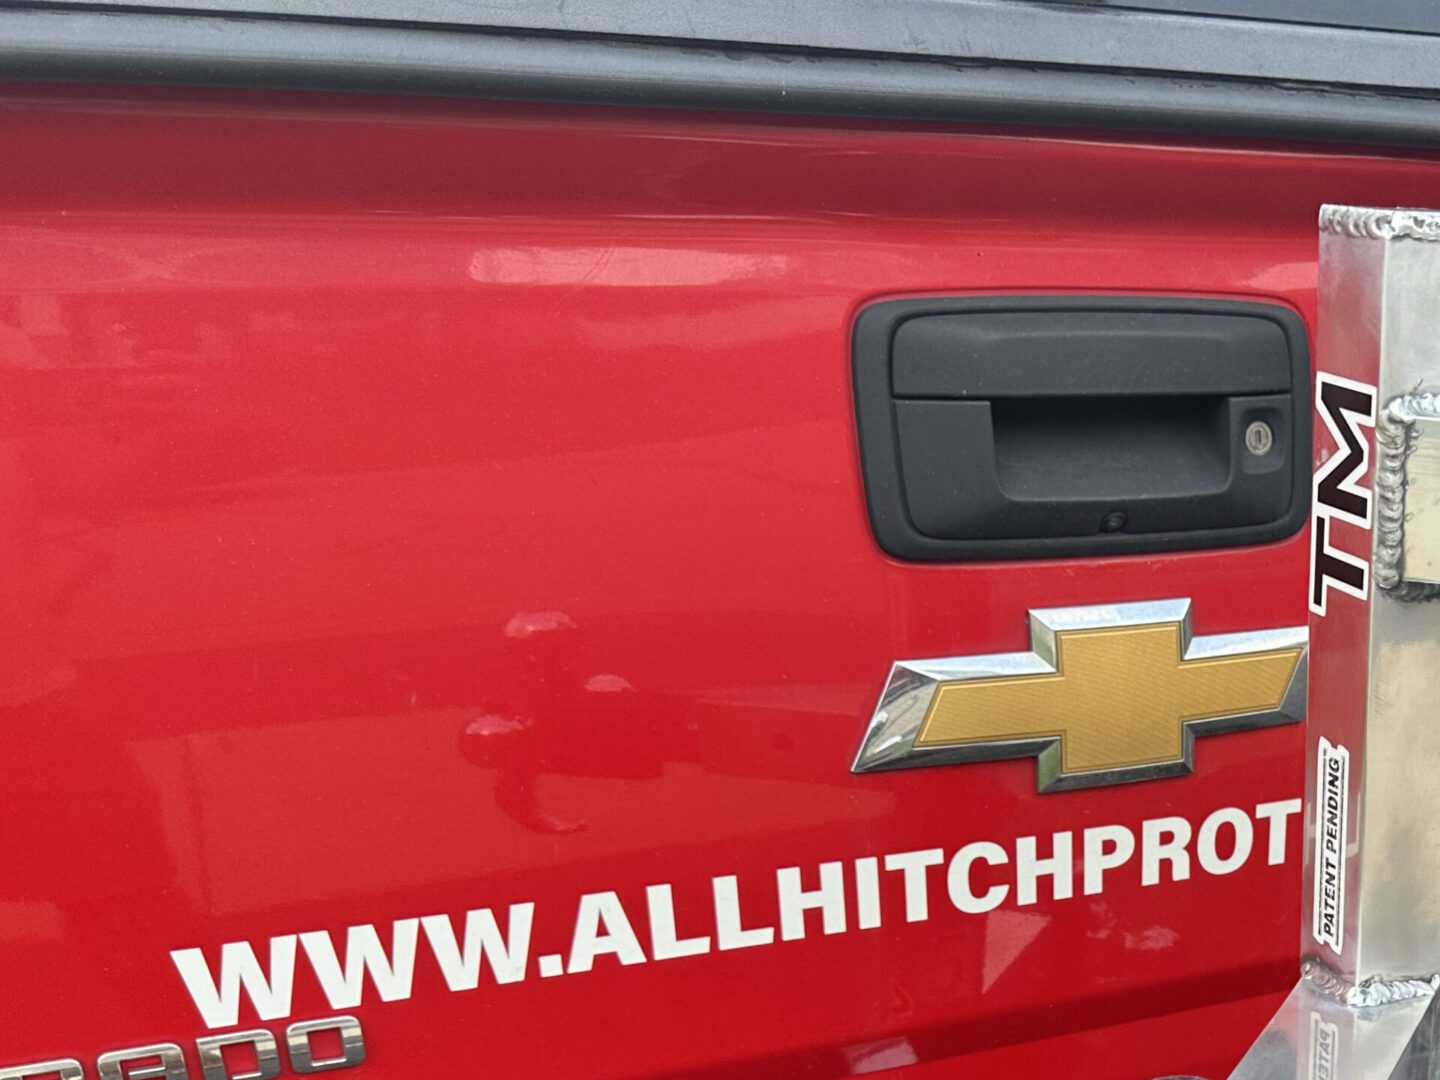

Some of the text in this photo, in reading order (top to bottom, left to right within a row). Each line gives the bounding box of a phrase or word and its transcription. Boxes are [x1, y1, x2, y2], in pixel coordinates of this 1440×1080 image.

[1311, 374, 1375, 613] TM
[1323, 755, 1341, 938] PATENT PENDING
